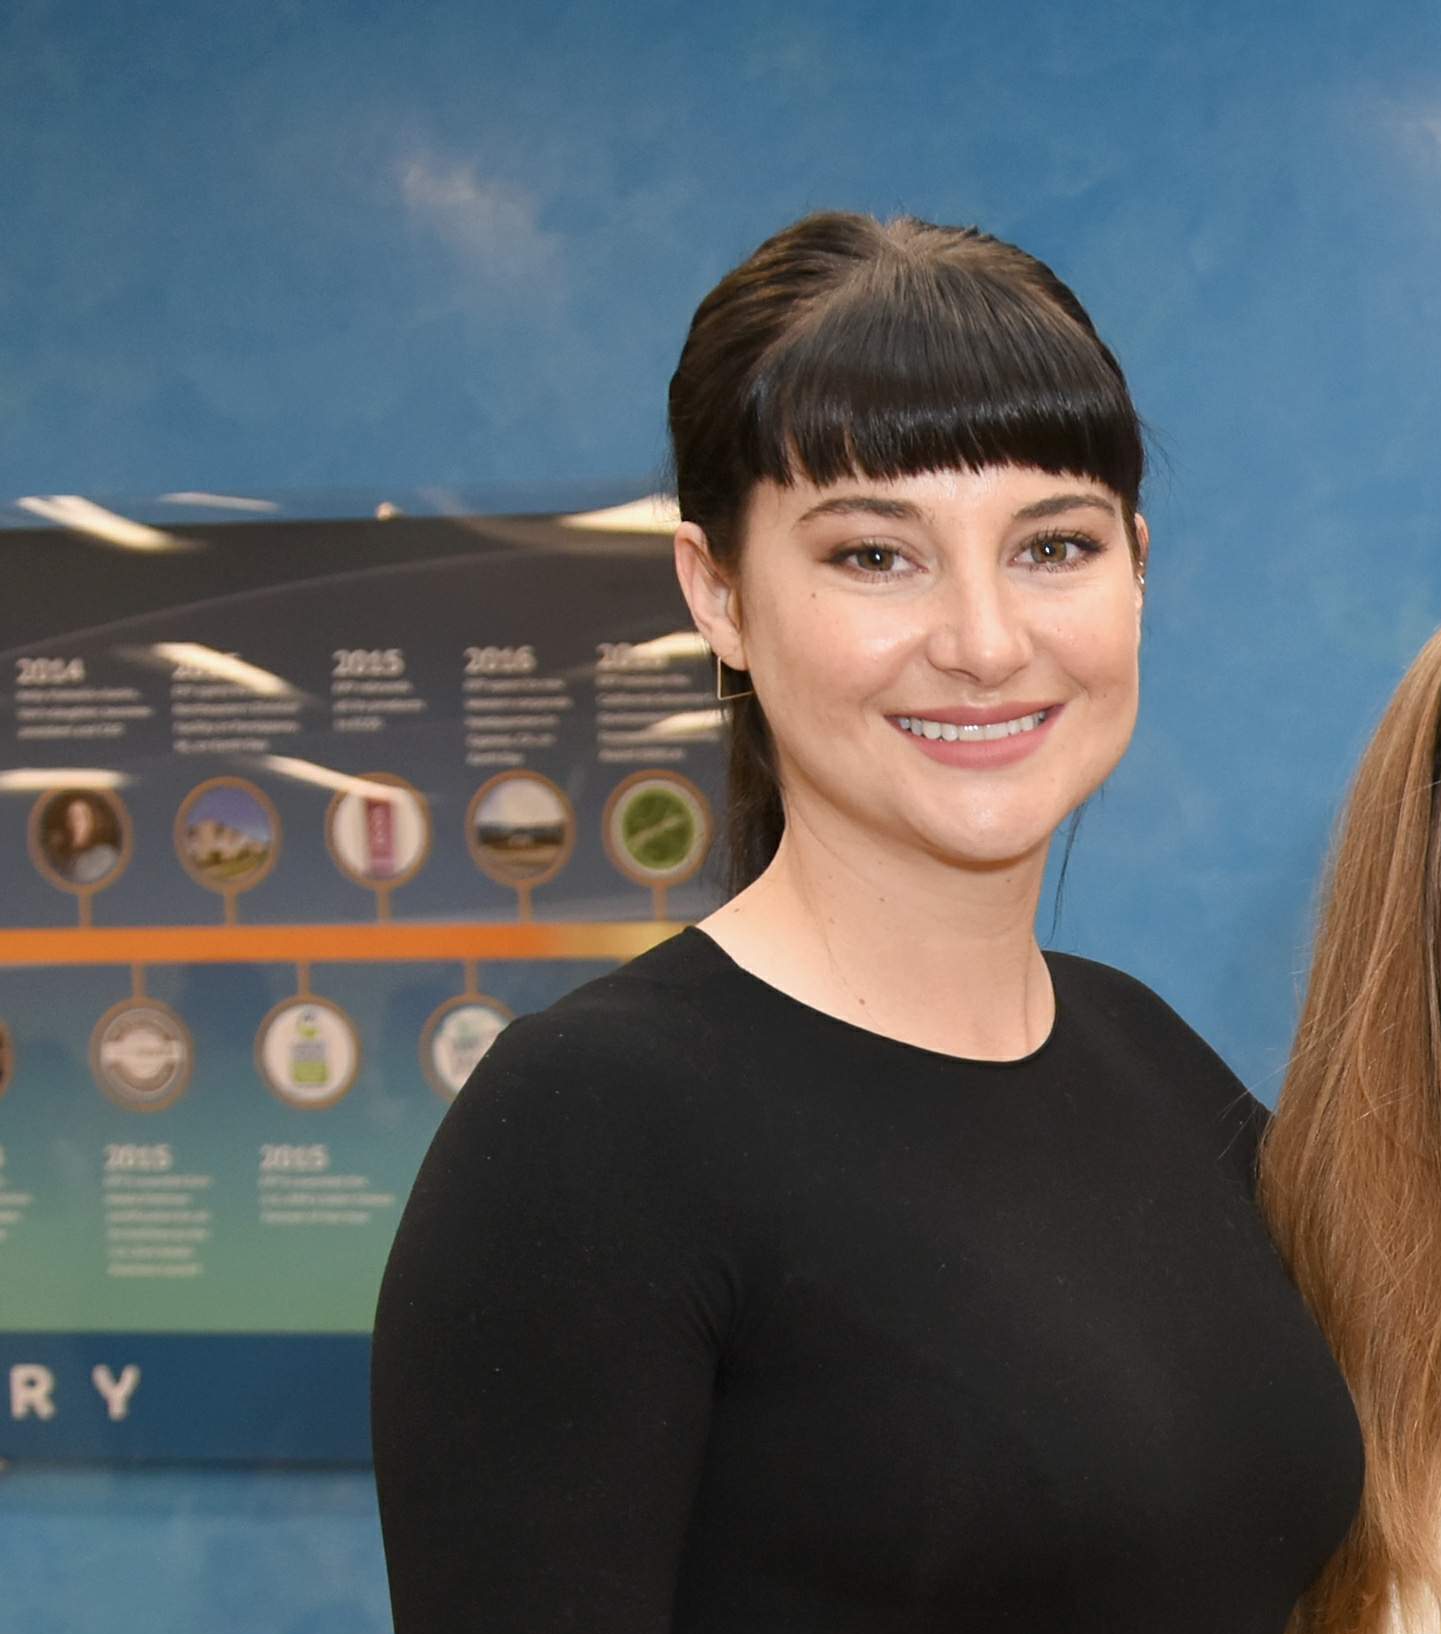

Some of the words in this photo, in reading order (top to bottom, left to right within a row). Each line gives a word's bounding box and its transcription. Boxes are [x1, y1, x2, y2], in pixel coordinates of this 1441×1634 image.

[332, 648, 405, 677] 2015
[463, 645, 537, 674] 2016
[103, 1143, 172, 1171] 2015
[260, 1143, 330, 1171] 2015
